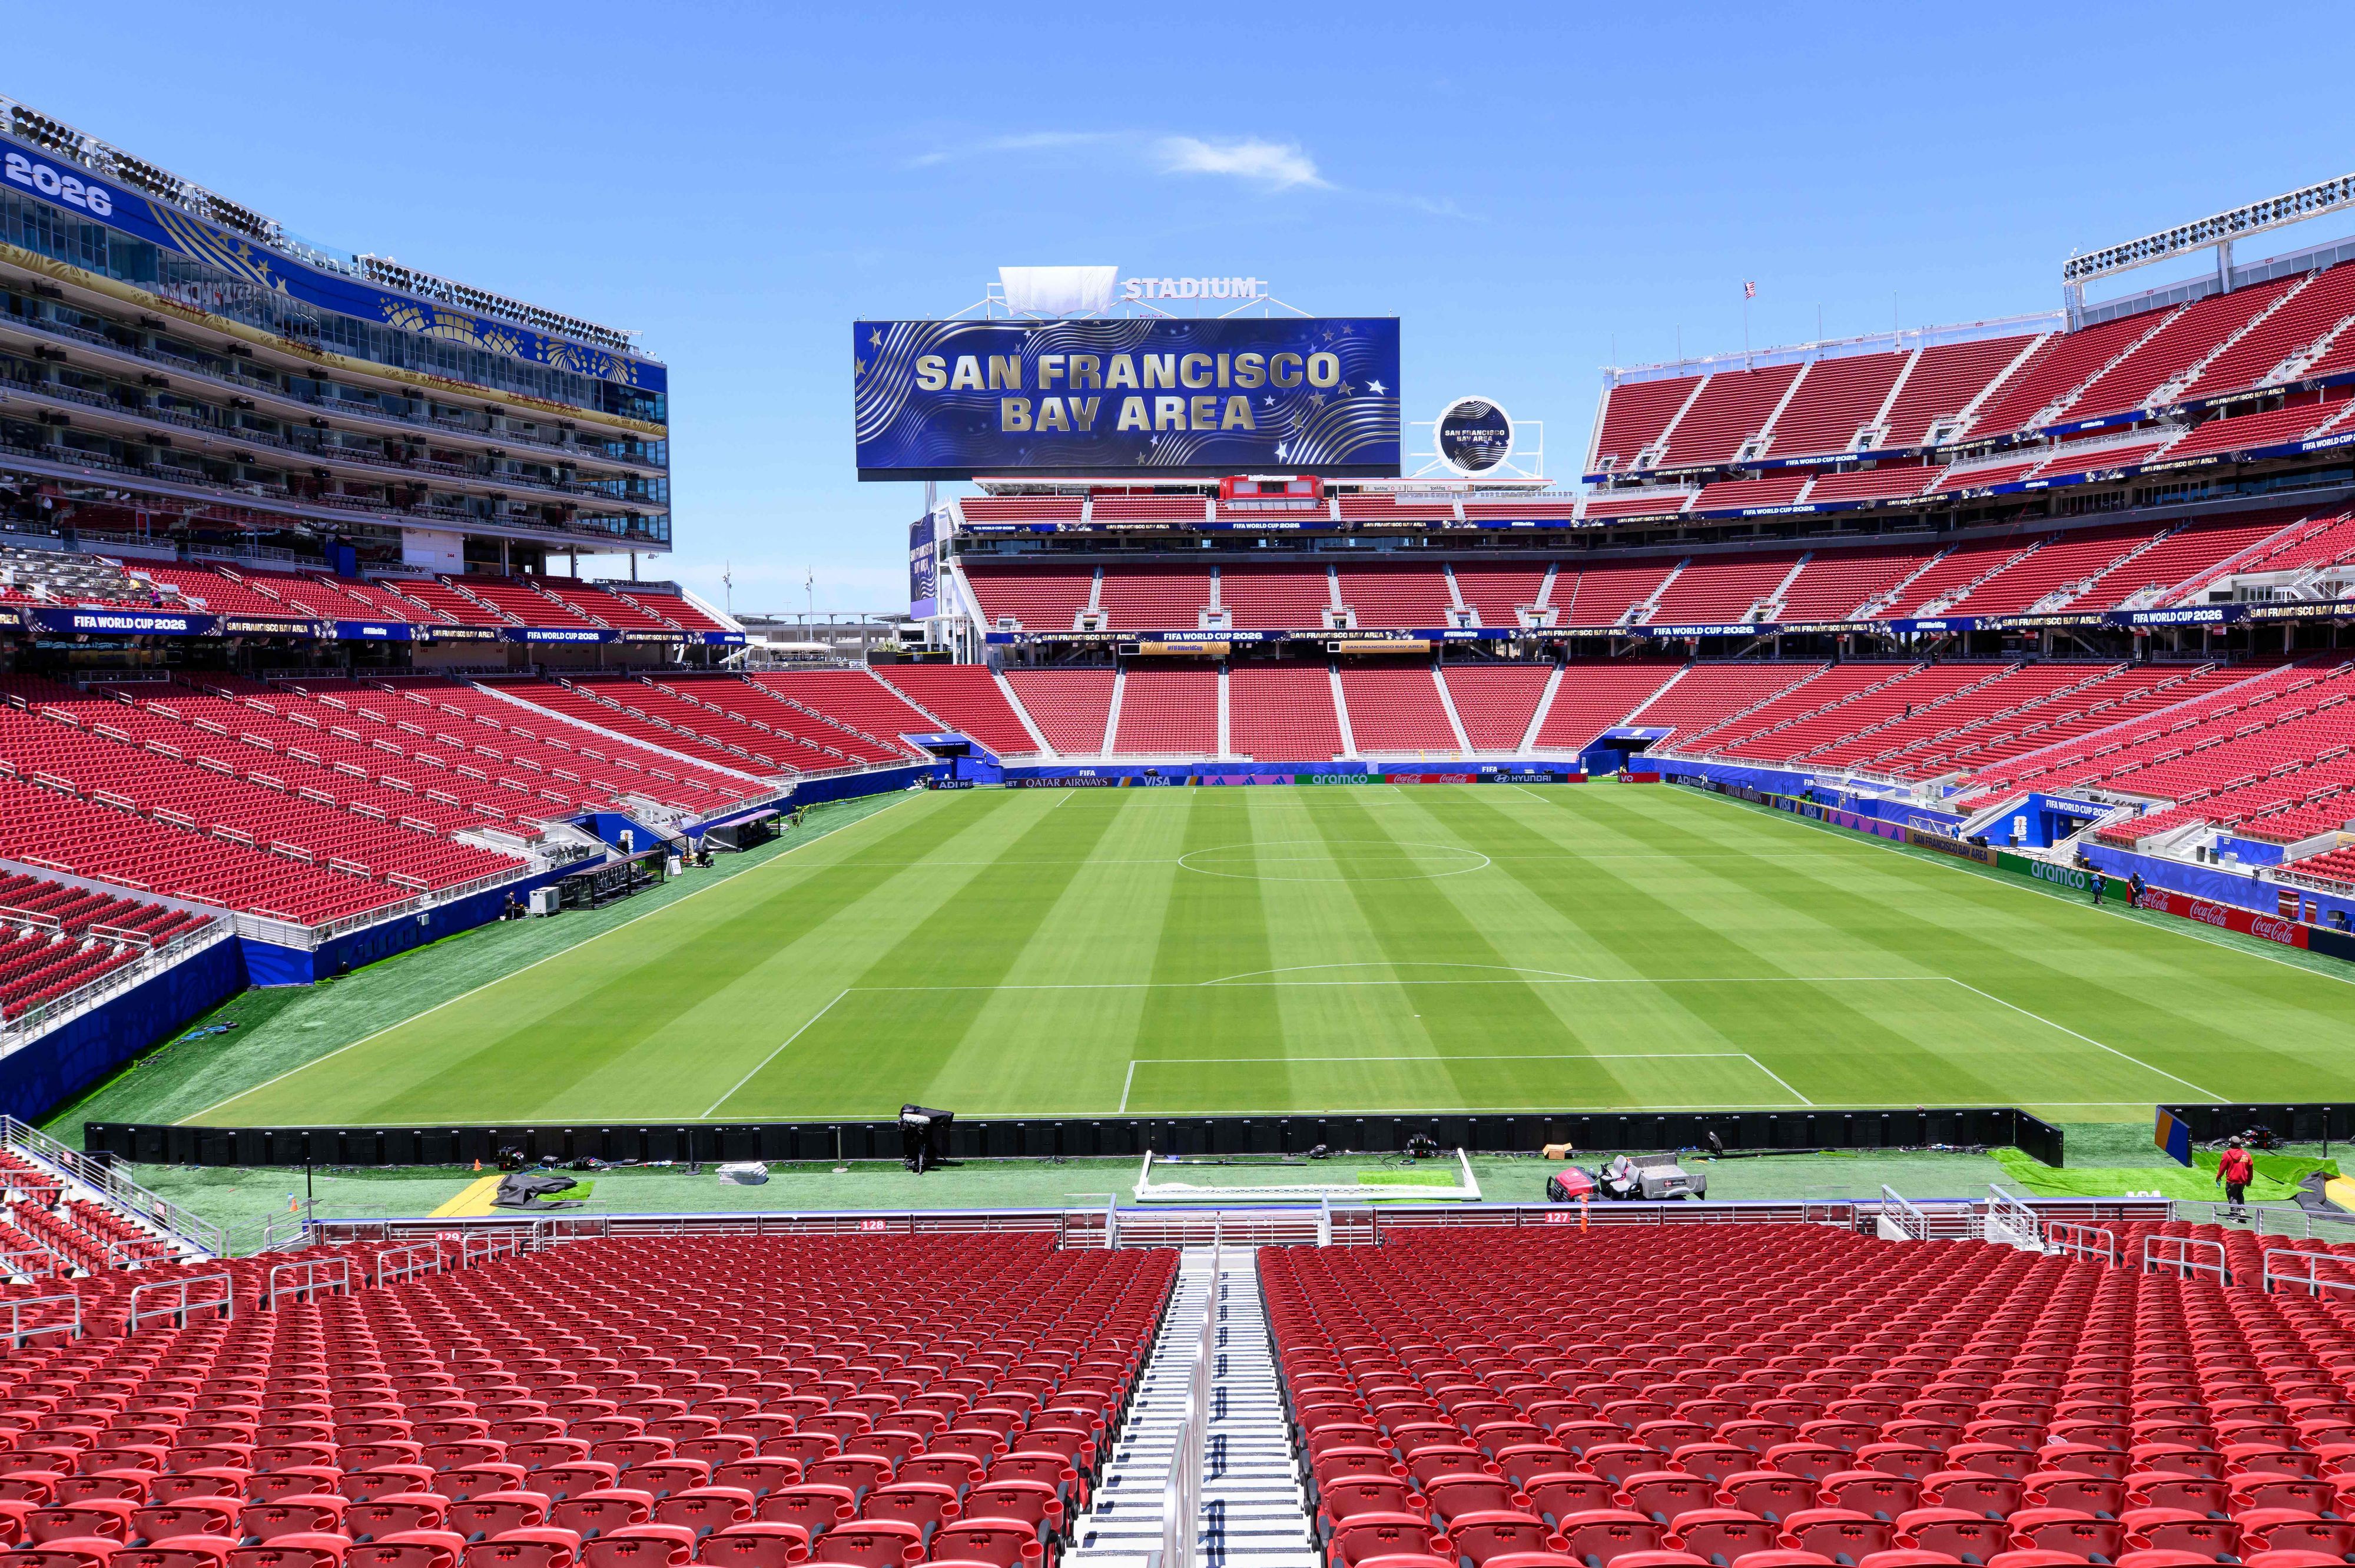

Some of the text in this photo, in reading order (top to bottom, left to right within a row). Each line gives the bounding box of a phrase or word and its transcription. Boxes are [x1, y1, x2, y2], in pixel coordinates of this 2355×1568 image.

[5, 153, 112, 216] 2026
[1126, 277, 1256, 299] STADIUM
[916, 352, 1339, 390] SAN FRANCISCO
[2218, 393, 2254, 405] FRANCISCO
[1001, 395, 1256, 432] BAY AREA
[2303, 442, 2316, 450] FIFA
[2316, 437, 2339, 447] WORLD
[2340, 434, 2353, 443] CUP
[2153, 460, 2187, 471] FRANCISCO
[2133, 609, 2223, 623] FIFA WORLD CUP 2026
[2251, 604, 2355, 618] SAN FRANCISCO BAY AREA
[74, 616, 186, 630] FIFA WORLD CUP 2026
[227, 622, 308, 633] SAN FRANCISCO BAY AREA
[2019, 617, 2061, 626] FRANCISCO
[2063, 616, 2078, 625] BAY
[2080, 616, 2102, 624] AREA
[1723, 626, 1754, 634] 2026
[1026, 778, 1107, 787] QATAR AIRWAYS
[1143, 777, 1170, 786] VISA
[1312, 774, 1368, 784] aramco
[1394, 774, 1422, 784] Coca-Cola
[1439, 774, 1468, 784] Coca-Cola
[1726, 784, 1740, 797] QATAR
[1742, 788, 1762, 803] AIRWAYS
[1779, 797, 1791, 811] VISA
[1804, 804, 1817, 818] VISA
[2046, 799, 2058, 808] FIFA
[2058, 801, 2079, 813] WORLD
[2080, 805, 2092, 814] CUP
[1913, 833, 1988, 861] SAN FRANCISCO BAY AREA
[2031, 860, 2085, 889] aramco
[2190, 901, 2229, 927] Coca-Cola
[2251, 916, 2295, 944] Coca-Cola
[1547, 1213, 1568, 1222] 127
[863, 1221, 884, 1229] 128
